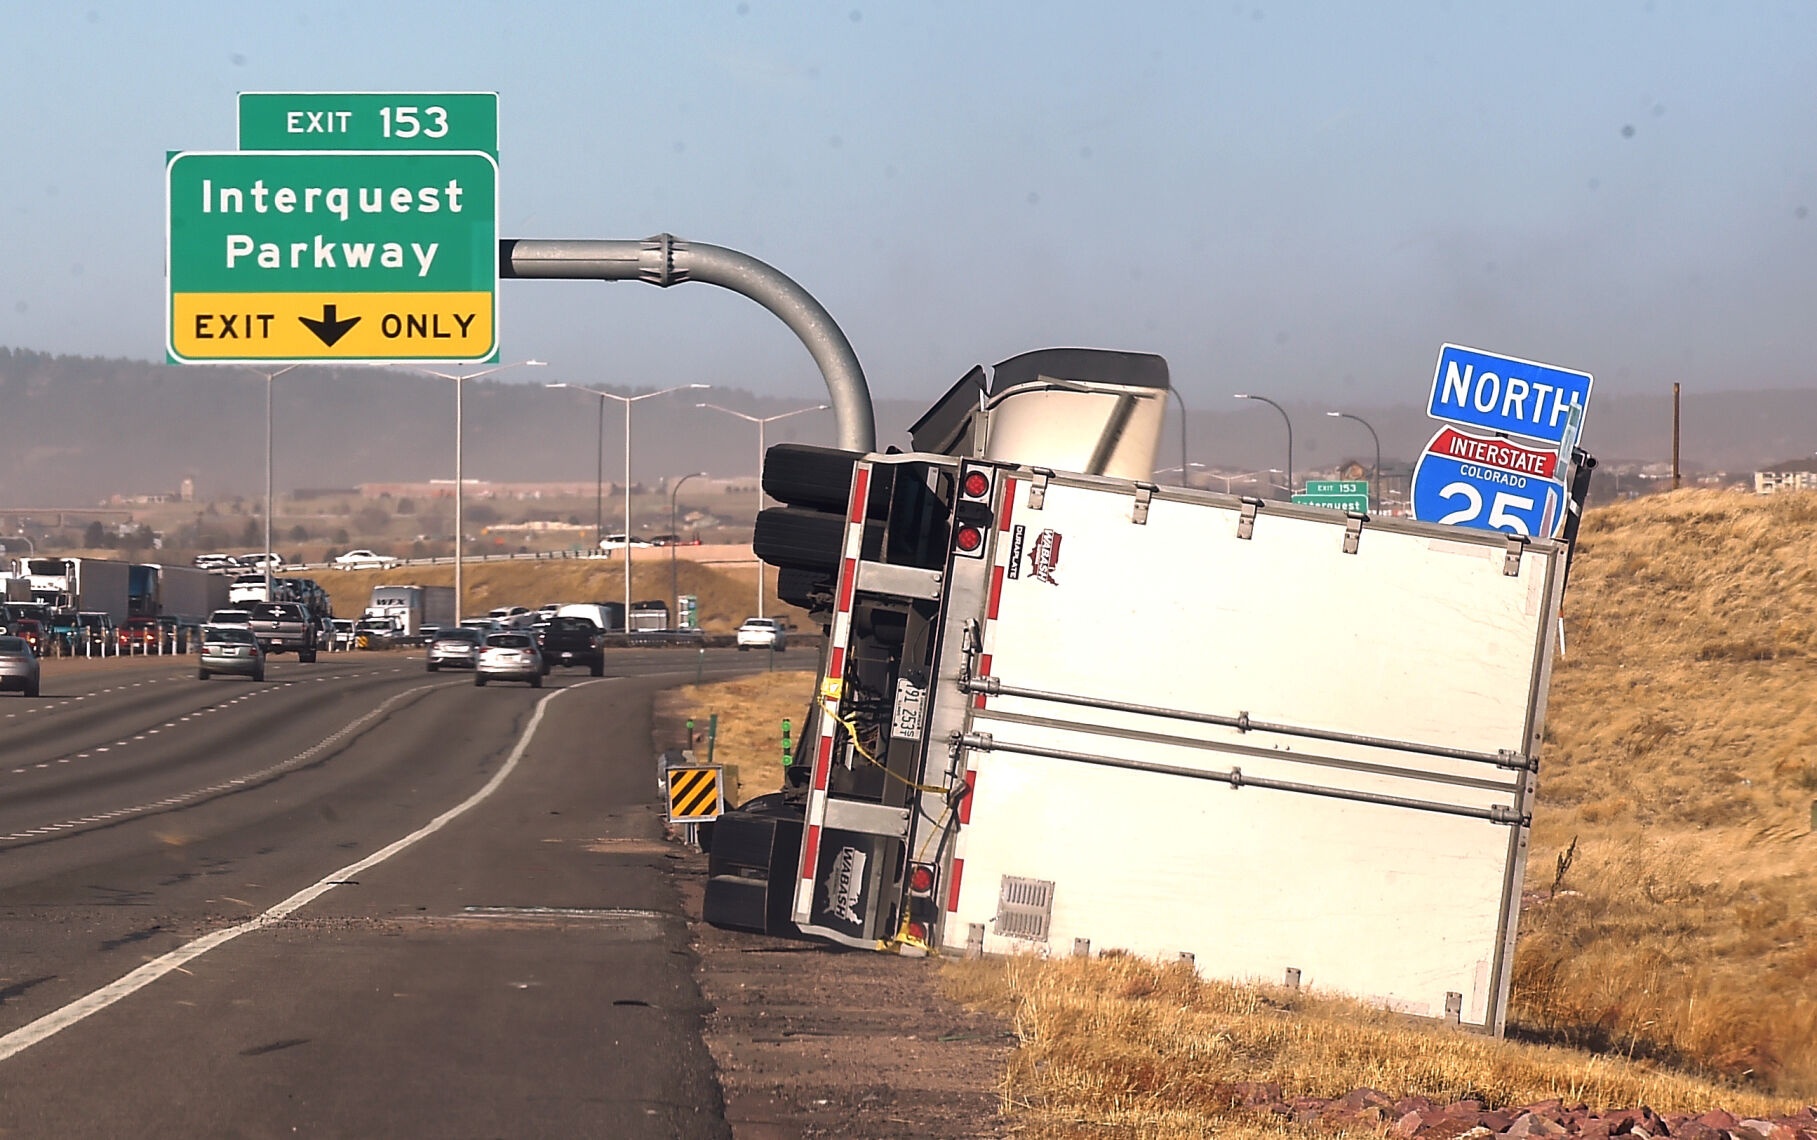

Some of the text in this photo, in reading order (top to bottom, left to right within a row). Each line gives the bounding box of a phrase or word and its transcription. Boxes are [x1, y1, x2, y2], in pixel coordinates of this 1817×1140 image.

[287, 106, 449, 138] EXIT 153
[203, 179, 463, 222] Interquest
[226, 234, 439, 277] Parkway
[195, 313, 477, 339] EXIT ONLY
[1441, 360, 1579, 427] NORTH
[1449, 436, 1547, 474] INTERSTATE
[1460, 464, 1527, 489] COLORADO
[1340, 484, 1357, 493] 153
[1438, 481, 1534, 536] 25
[1009, 526, 1024, 579] DURAPLATE
[1037, 529, 1053, 583] WABASH
[901, 708, 917, 730] 253
[836, 848, 854, 918] WABASH
